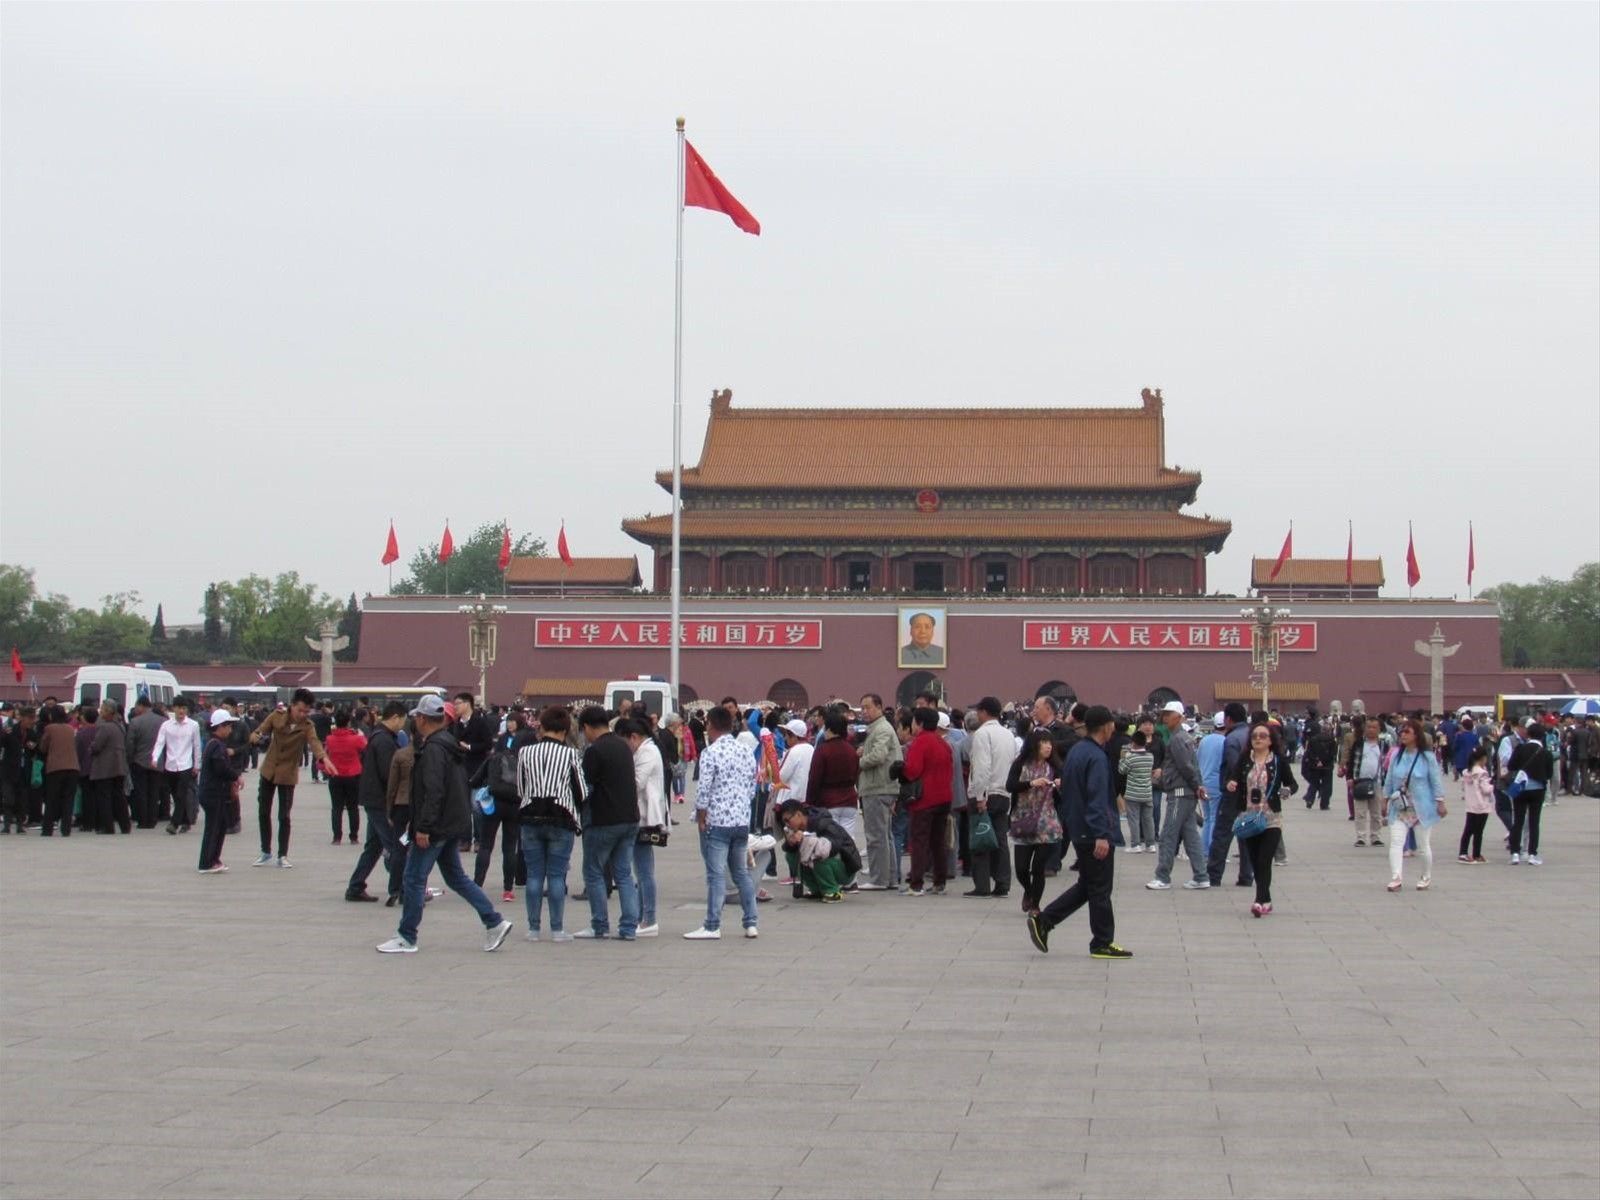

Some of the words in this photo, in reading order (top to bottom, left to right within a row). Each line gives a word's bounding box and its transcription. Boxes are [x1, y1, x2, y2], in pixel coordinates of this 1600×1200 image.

[550, 623, 805, 644] 中华人民共和国万岁
[1041, 626, 1301, 646] 世界人民大团结岁
